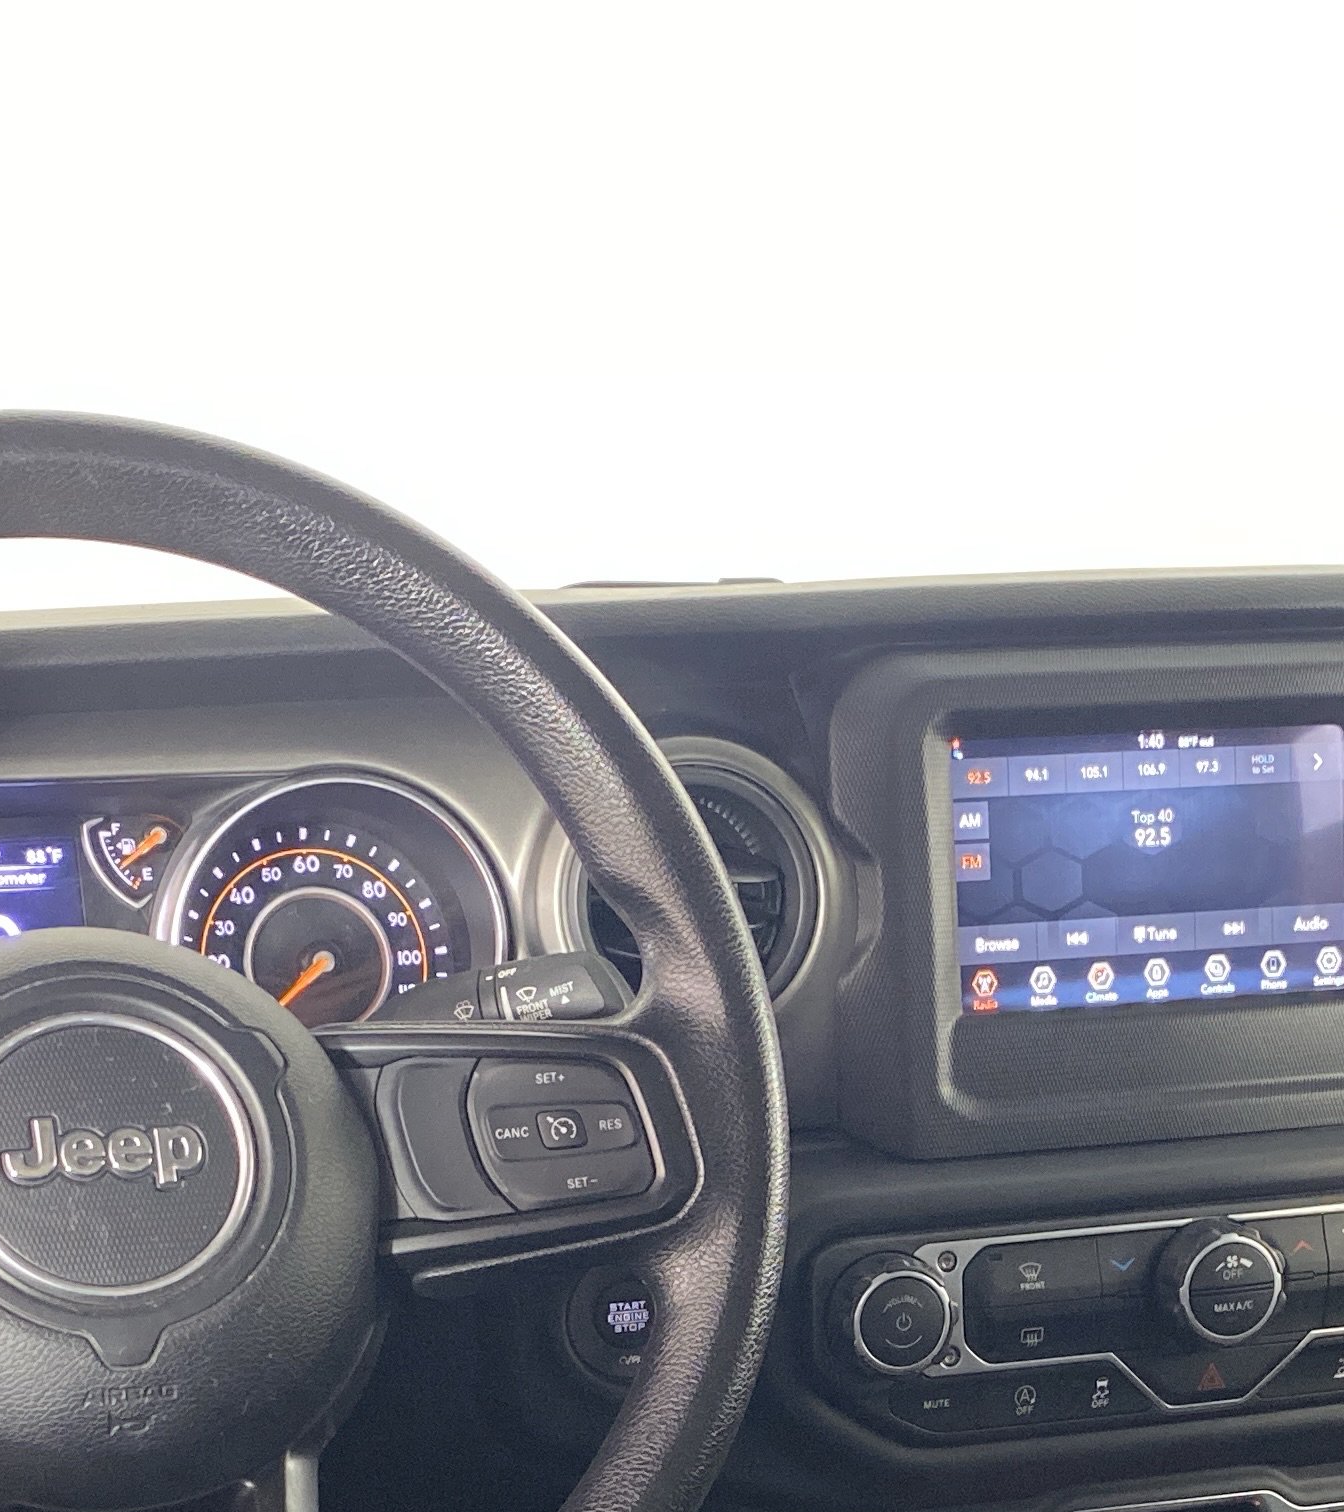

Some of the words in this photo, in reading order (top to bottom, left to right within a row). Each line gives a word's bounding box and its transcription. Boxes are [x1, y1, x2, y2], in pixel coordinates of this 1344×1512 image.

[1137, 733, 1164, 749] 1:40
[1251, 754, 1275, 764] HOLD
[1080, 765, 1108, 780] 105.1
[1138, 763, 1165, 777] 106.9
[1196, 760, 1219, 774] 97.3
[1262, 765, 1274, 774] Set
[967, 770, 991, 785] 92.5
[1025, 768, 1048, 783] 94.1
[959, 814, 982, 829] AM
[1132, 810, 1154, 827] Top
[1157, 808, 1173, 823] 40
[111, 823, 120, 836] F
[1134, 828, 1171, 847] 92.5
[293, 855, 320, 874] 60
[962, 855, 983, 870] FM
[142, 867, 153, 882] E
[261, 867, 281, 883] 50
[333, 864, 353, 879] 70
[230, 886, 255, 905] 40
[362, 880, 386, 899] 80
[387, 911, 408, 927] 90
[1294, 916, 1329, 932] Audio
[214, 919, 235, 936] 30
[1146, 926, 1177, 942] Tune
[975, 936, 1020, 954] Browse
[397, 949, 422, 966] 100
[498, 967, 517, 978] OFF
[549, 980, 575, 997] MIST
[516, 999, 549, 1015] FRONT
[599, 1118, 623, 1131] RES
[495, 1126, 530, 1139] CANC
[1, 1116, 204, 1186] Jeep
[1222, 1267, 1243, 1281] OFF
[1020, 1280, 1046, 1291] FRONT
[609, 1300, 646, 1312] START
[1214, 1302, 1235, 1312] MAX
[1236, 1300, 1254, 1311] A/C
[607, 1311, 649, 1323] ENGINE
[614, 1323, 646, 1334] STOP
[923, 1399, 950, 1410] MUTE
[1016, 1405, 1034, 1416] OFF
[1092, 1399, 1110, 1409] OFF
